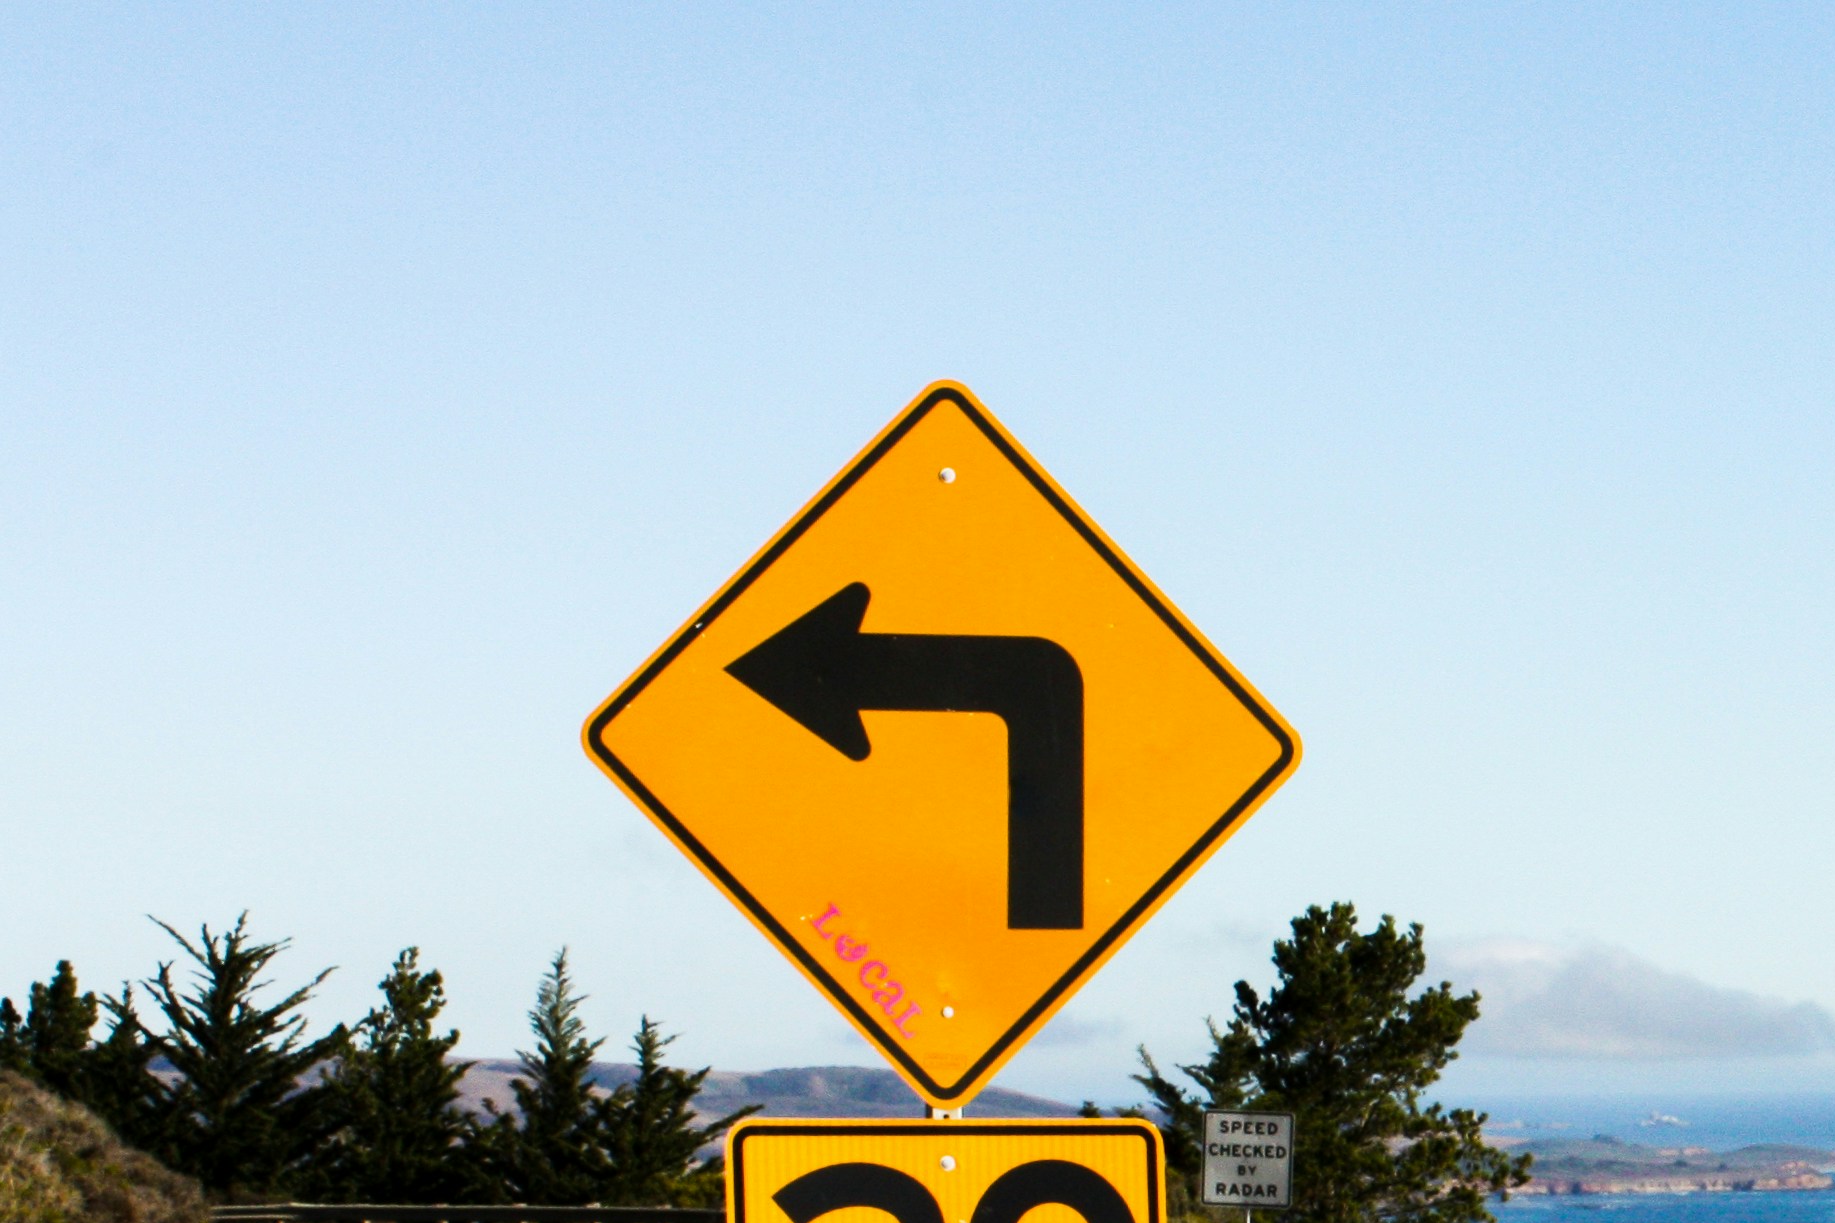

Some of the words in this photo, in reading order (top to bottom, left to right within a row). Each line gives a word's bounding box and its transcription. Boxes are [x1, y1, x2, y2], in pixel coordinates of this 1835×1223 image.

[1220, 1121, 1278, 1134] SPEED
[1209, 1144, 1286, 1158] CHECKED
[1237, 1165, 1256, 1176] BY
[1216, 1183, 1277, 1197] RADAR
